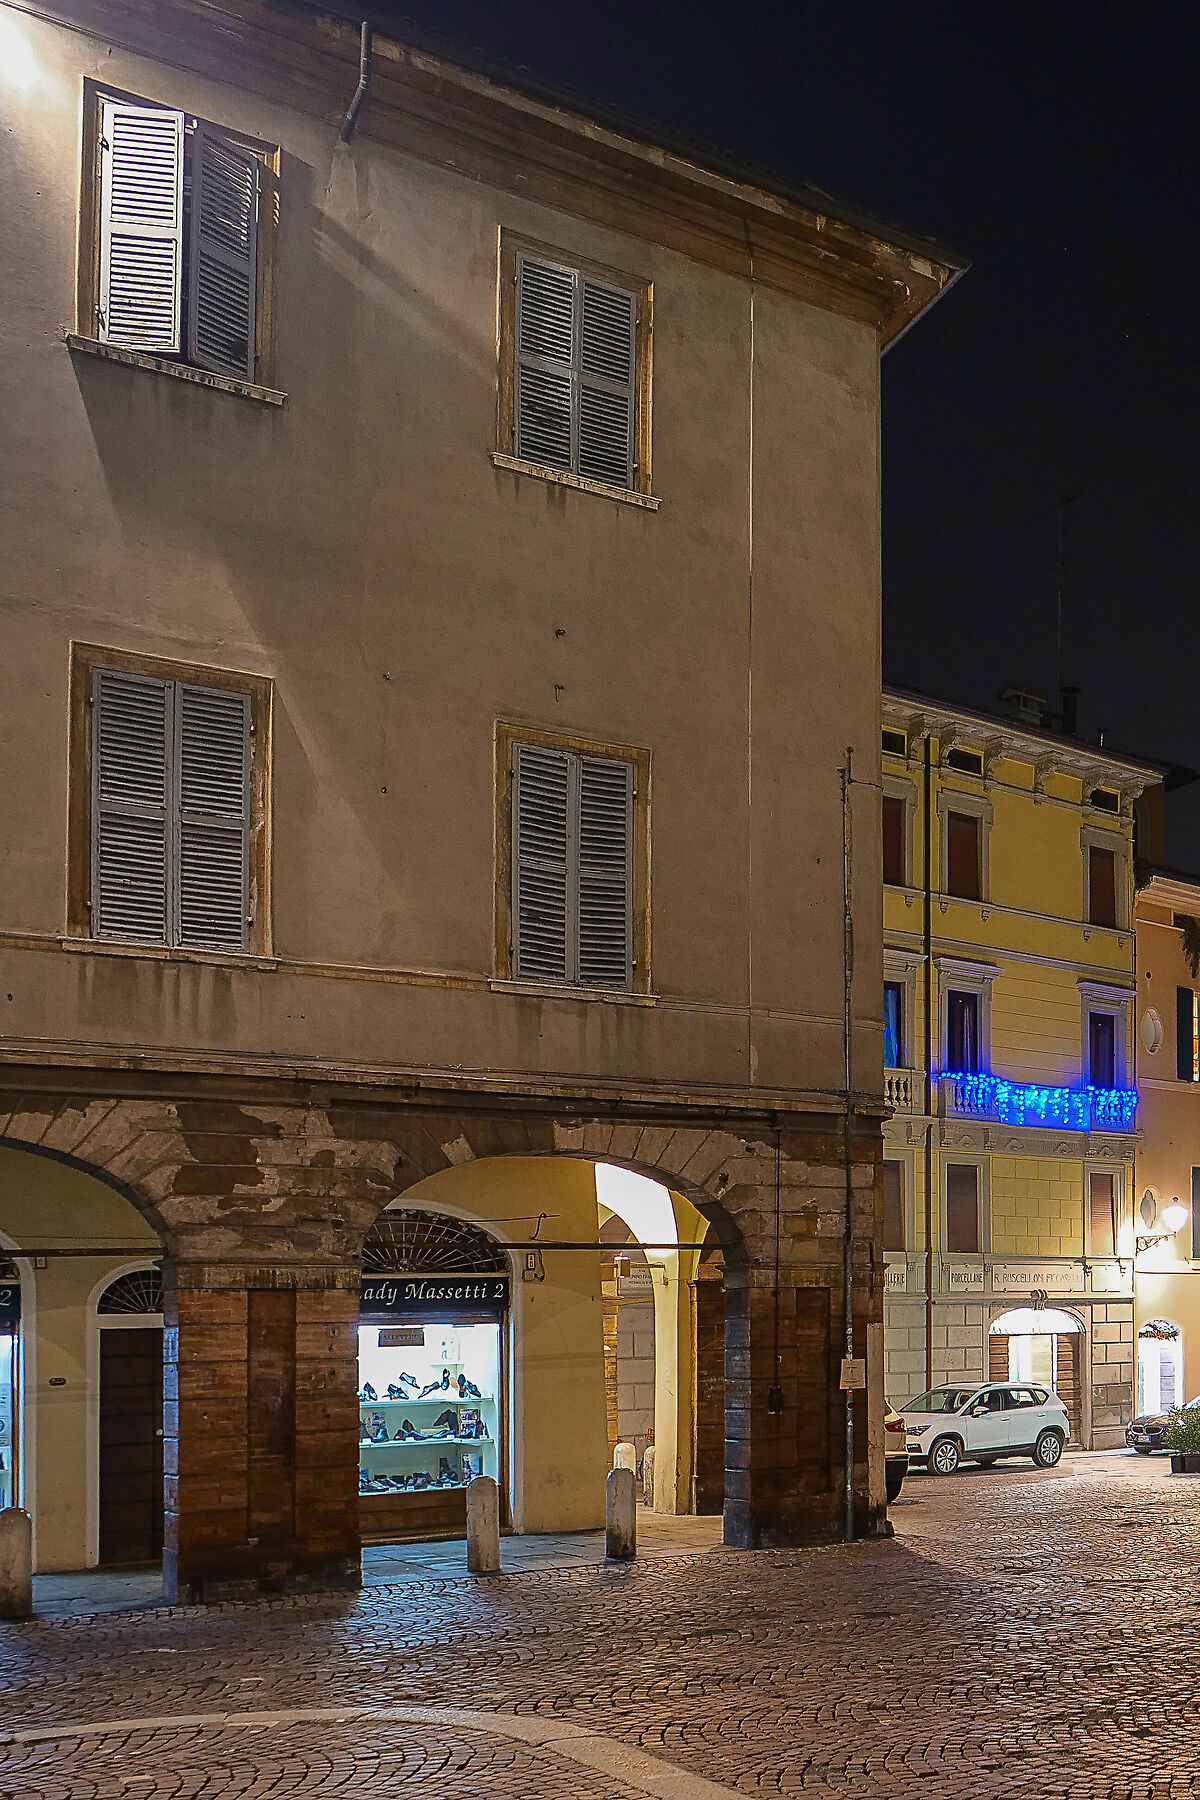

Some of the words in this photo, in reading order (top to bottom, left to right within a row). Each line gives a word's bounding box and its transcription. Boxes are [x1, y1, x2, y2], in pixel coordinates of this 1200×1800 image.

[951, 1273, 983, 1284] PORCELLANE
[0, 1289, 12, 1306] 2
[360, 1281, 398, 1306] ady
[404, 1281, 488, 1300] Massetti
[493, 1283, 504, 1299] 2
